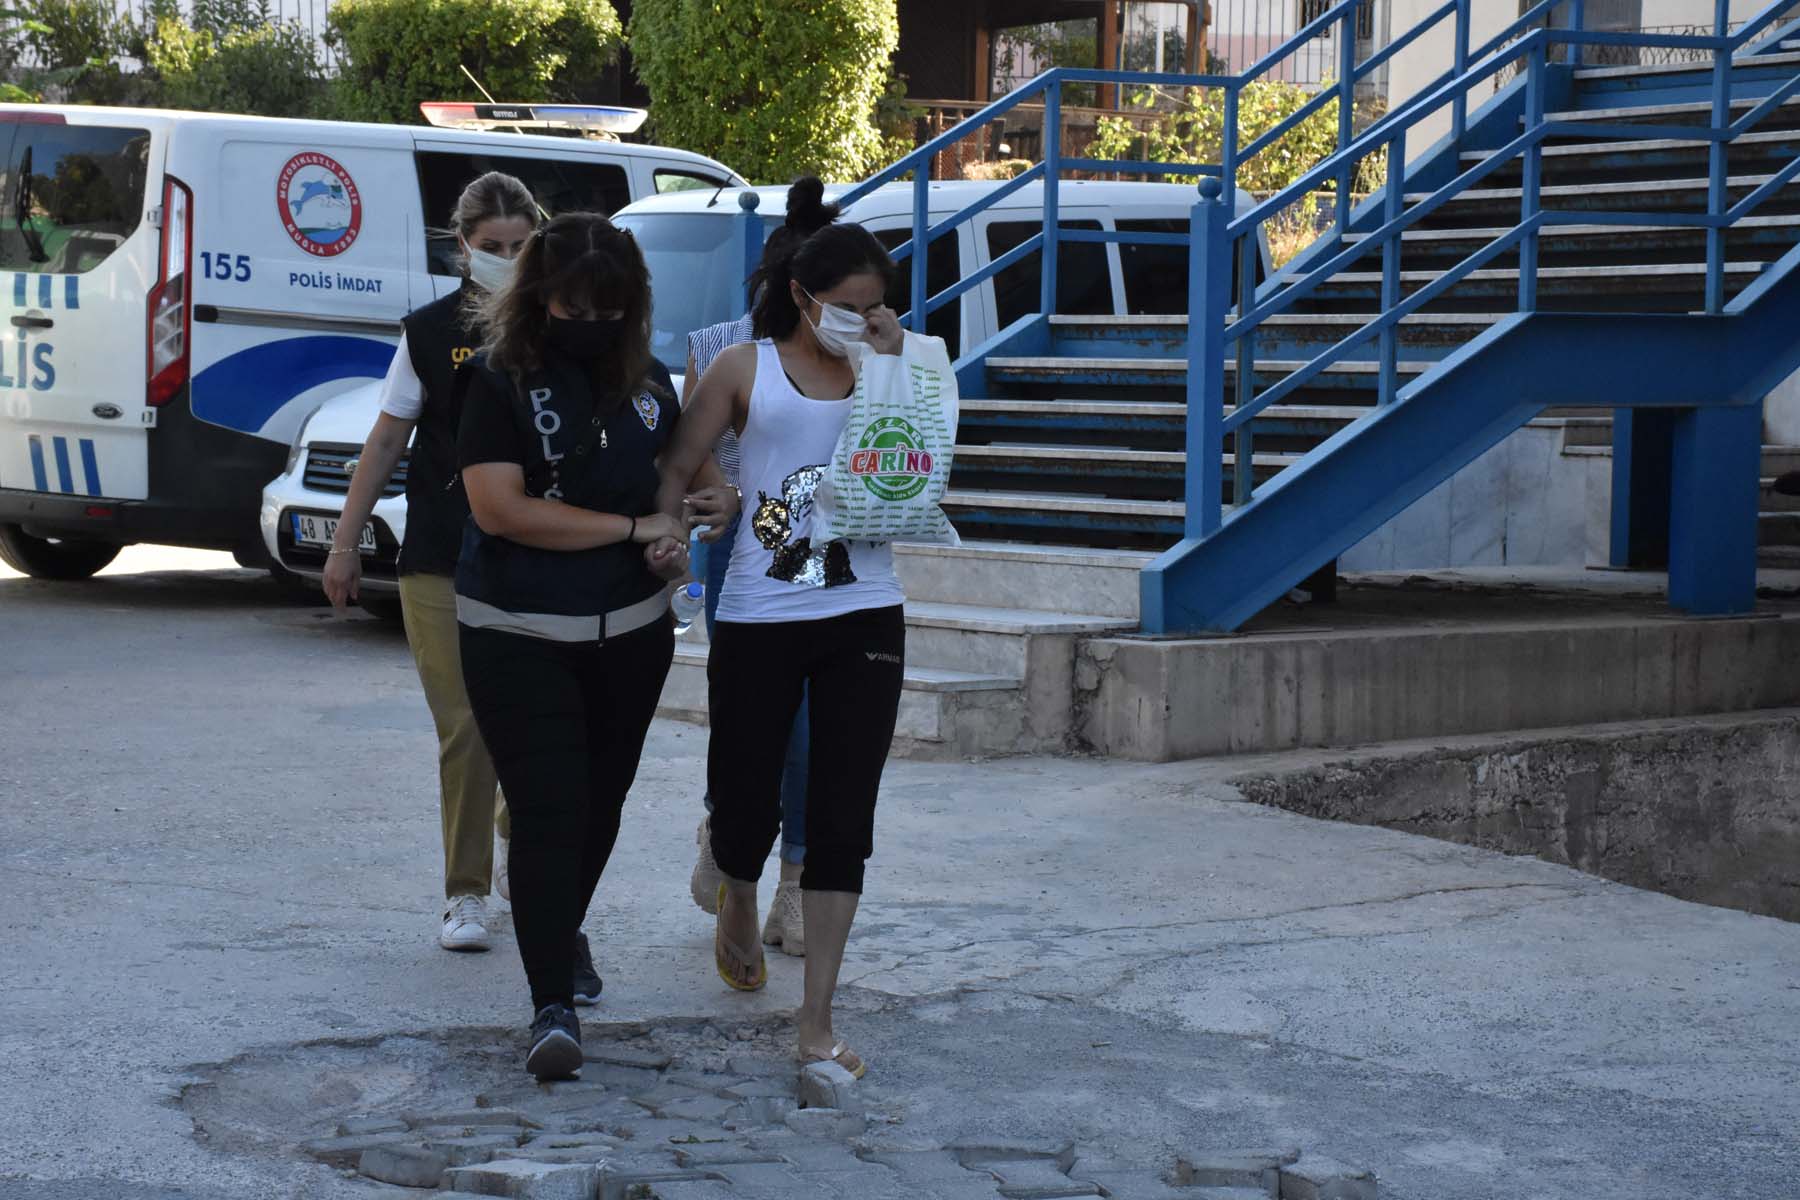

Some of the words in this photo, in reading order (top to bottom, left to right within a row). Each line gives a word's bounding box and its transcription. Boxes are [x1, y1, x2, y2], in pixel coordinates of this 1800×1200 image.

[200, 251, 252, 282] 155
[289, 271, 332, 289] POLİS
[336, 272, 382, 293] İMDAT
[863, 417, 922, 445] SEZAR
[301, 517, 316, 540] 48
